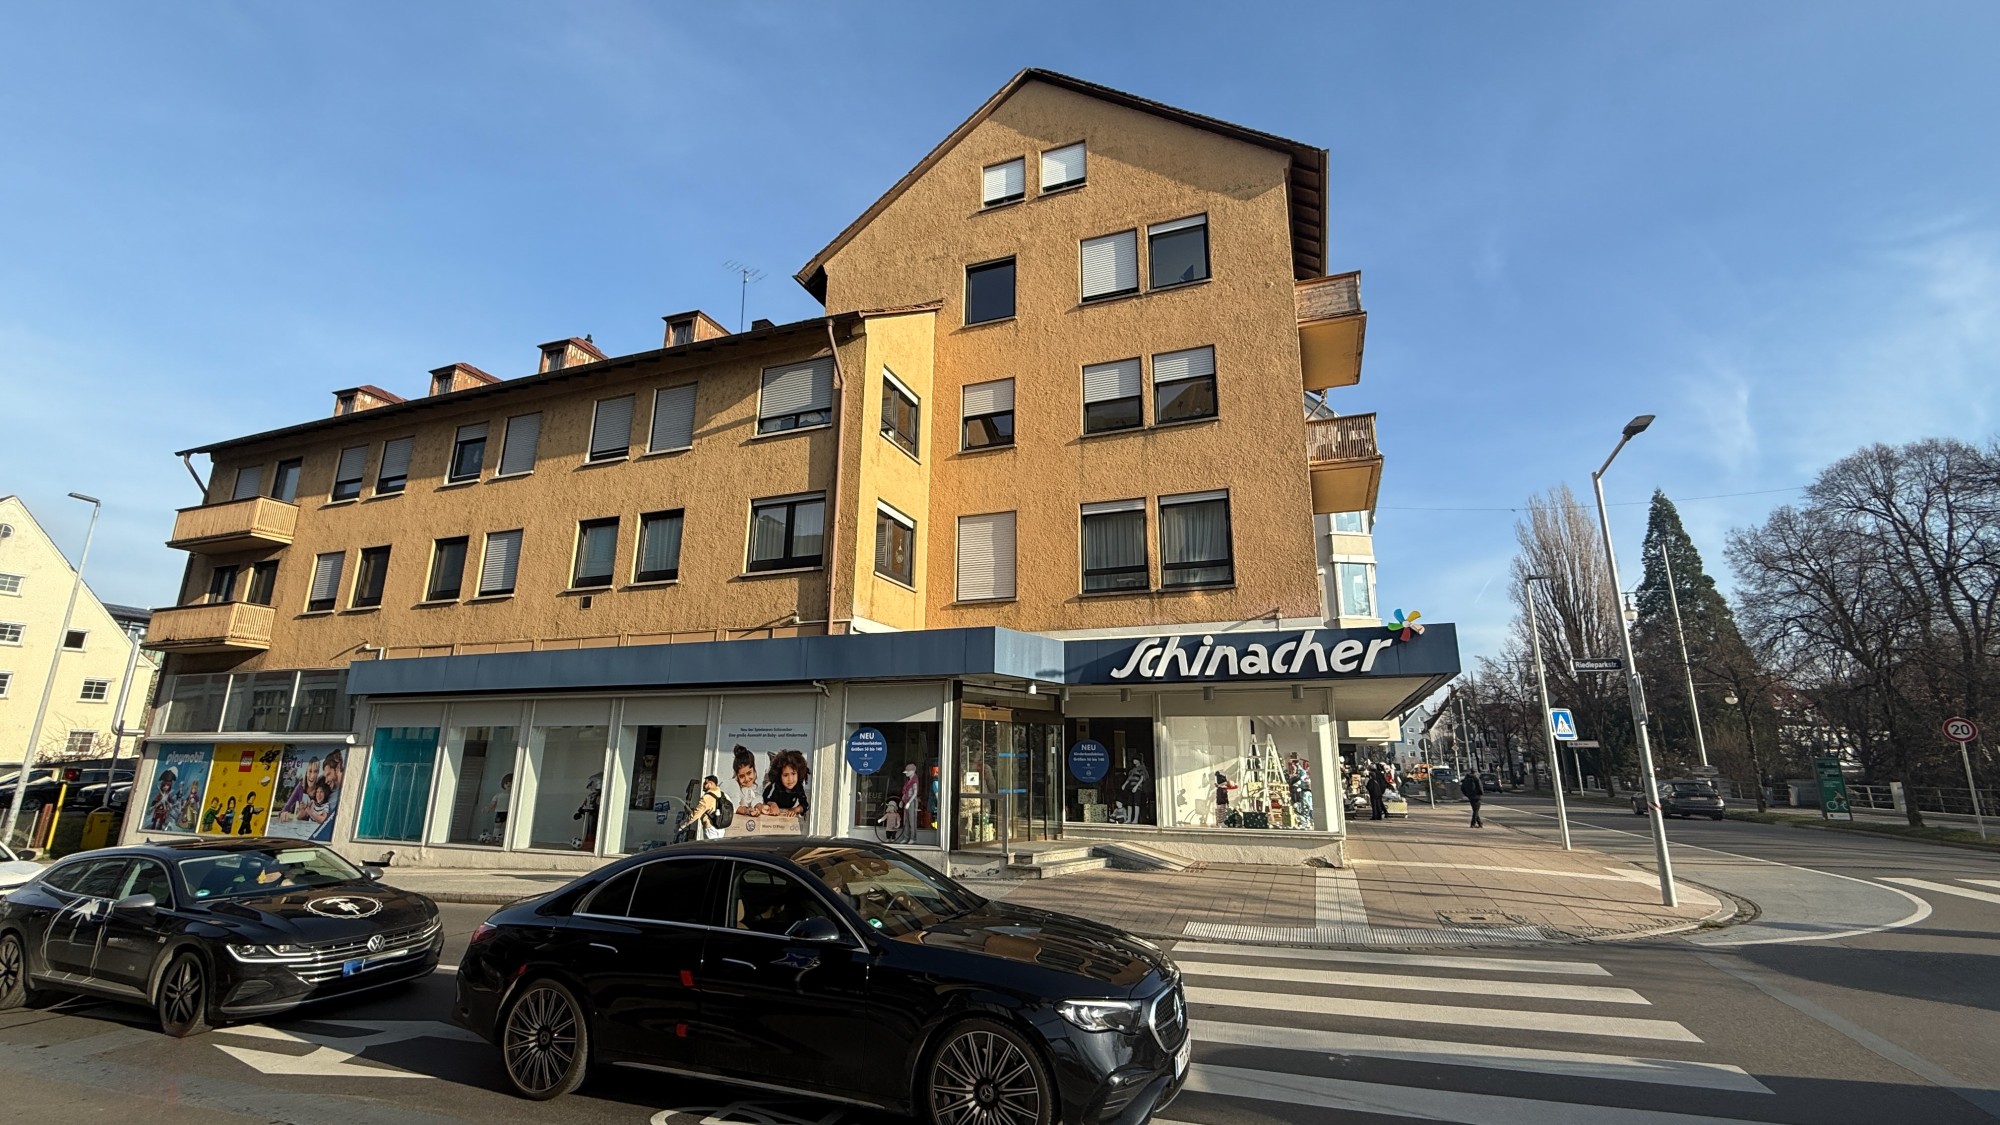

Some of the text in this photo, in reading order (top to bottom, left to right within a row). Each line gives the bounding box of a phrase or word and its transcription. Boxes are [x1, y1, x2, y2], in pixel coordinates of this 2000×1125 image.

[1110, 630, 1393, 679] Schinacher
[1575, 661, 1619, 669] Riedleparkstr.
[1950, 724, 1970, 735] 20
[859, 732, 875, 740] NEU
[165, 751, 205, 765] playmobil
